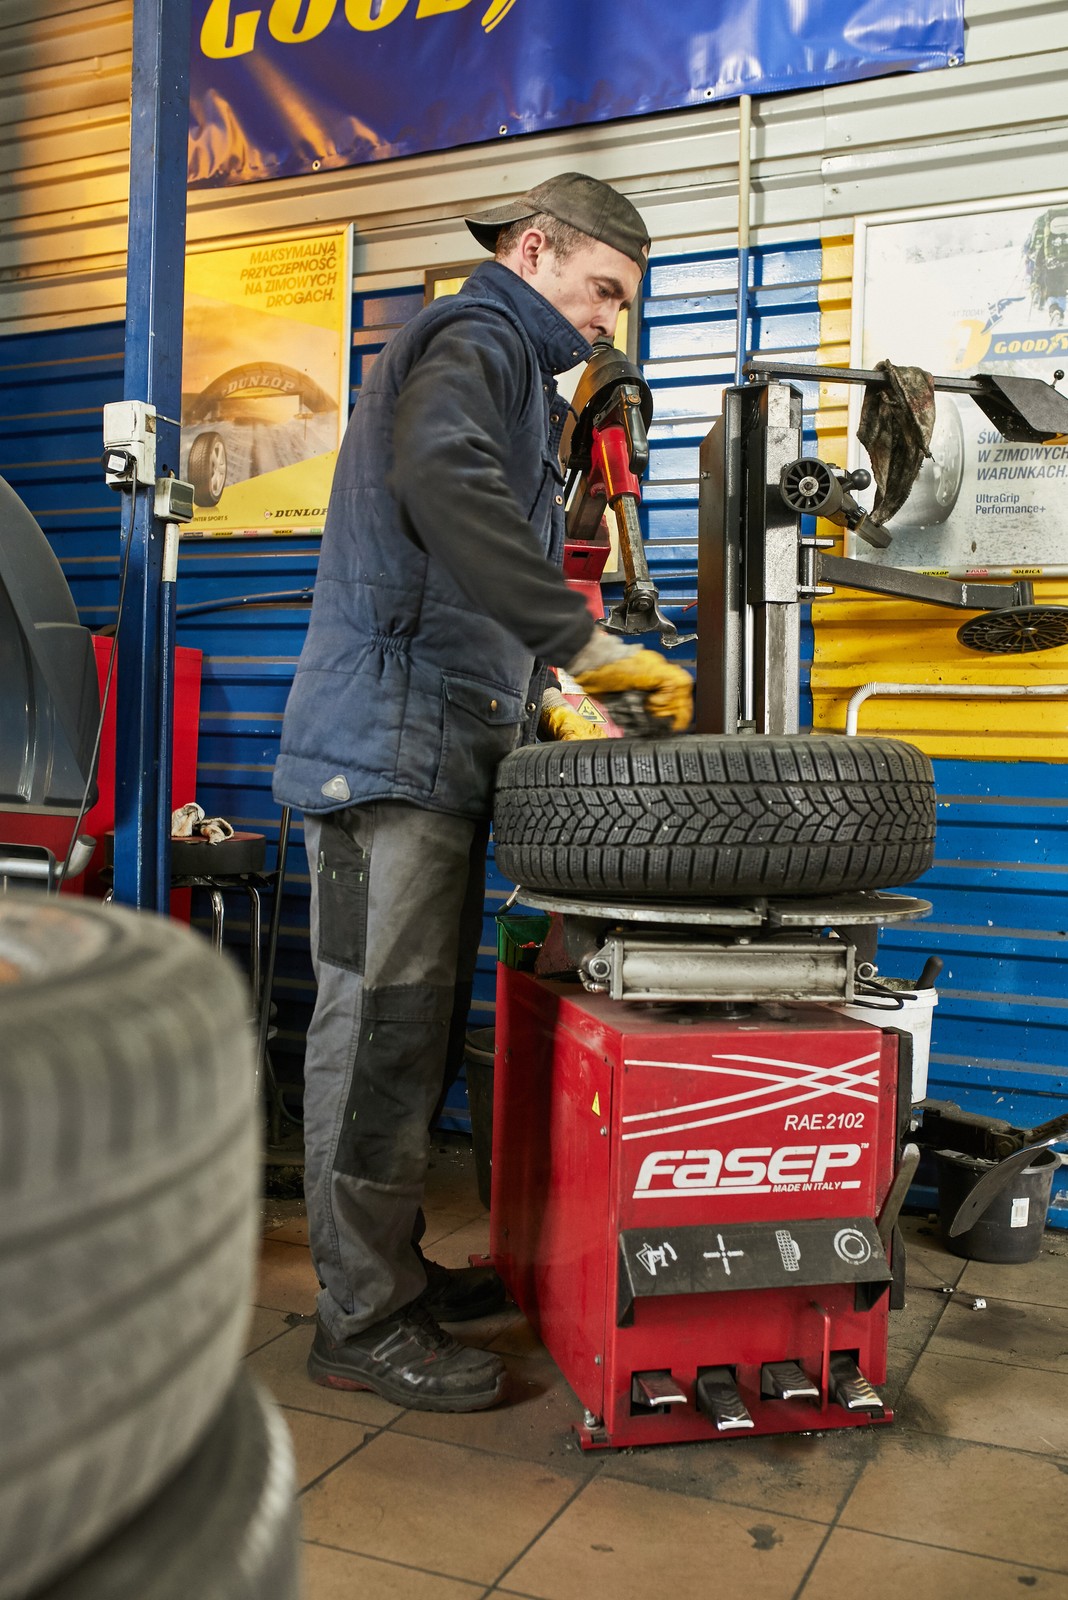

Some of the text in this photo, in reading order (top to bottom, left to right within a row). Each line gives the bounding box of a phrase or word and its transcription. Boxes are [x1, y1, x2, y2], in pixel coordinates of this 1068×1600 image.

[250, 241, 337, 264] MAKSYMALNĄ
[240, 255, 337, 281] PRZYCZEPNOŚĆ
[245, 272, 338, 295] NA ZIMOWYCH
[266, 288, 335, 308] DROGACH.
[227, 375, 296, 394] DUNLOP
[978, 446, 1068, 463] W ZIMOWYCH
[977, 465, 1068, 480] WARUNKACH.
[976, 493, 1020, 504] UltraGrip
[976, 504, 1046, 514] Performance+
[784, 1113, 865, 1131] RAE.2102
[773, 1181, 841, 1192] MADE IN ITALY
